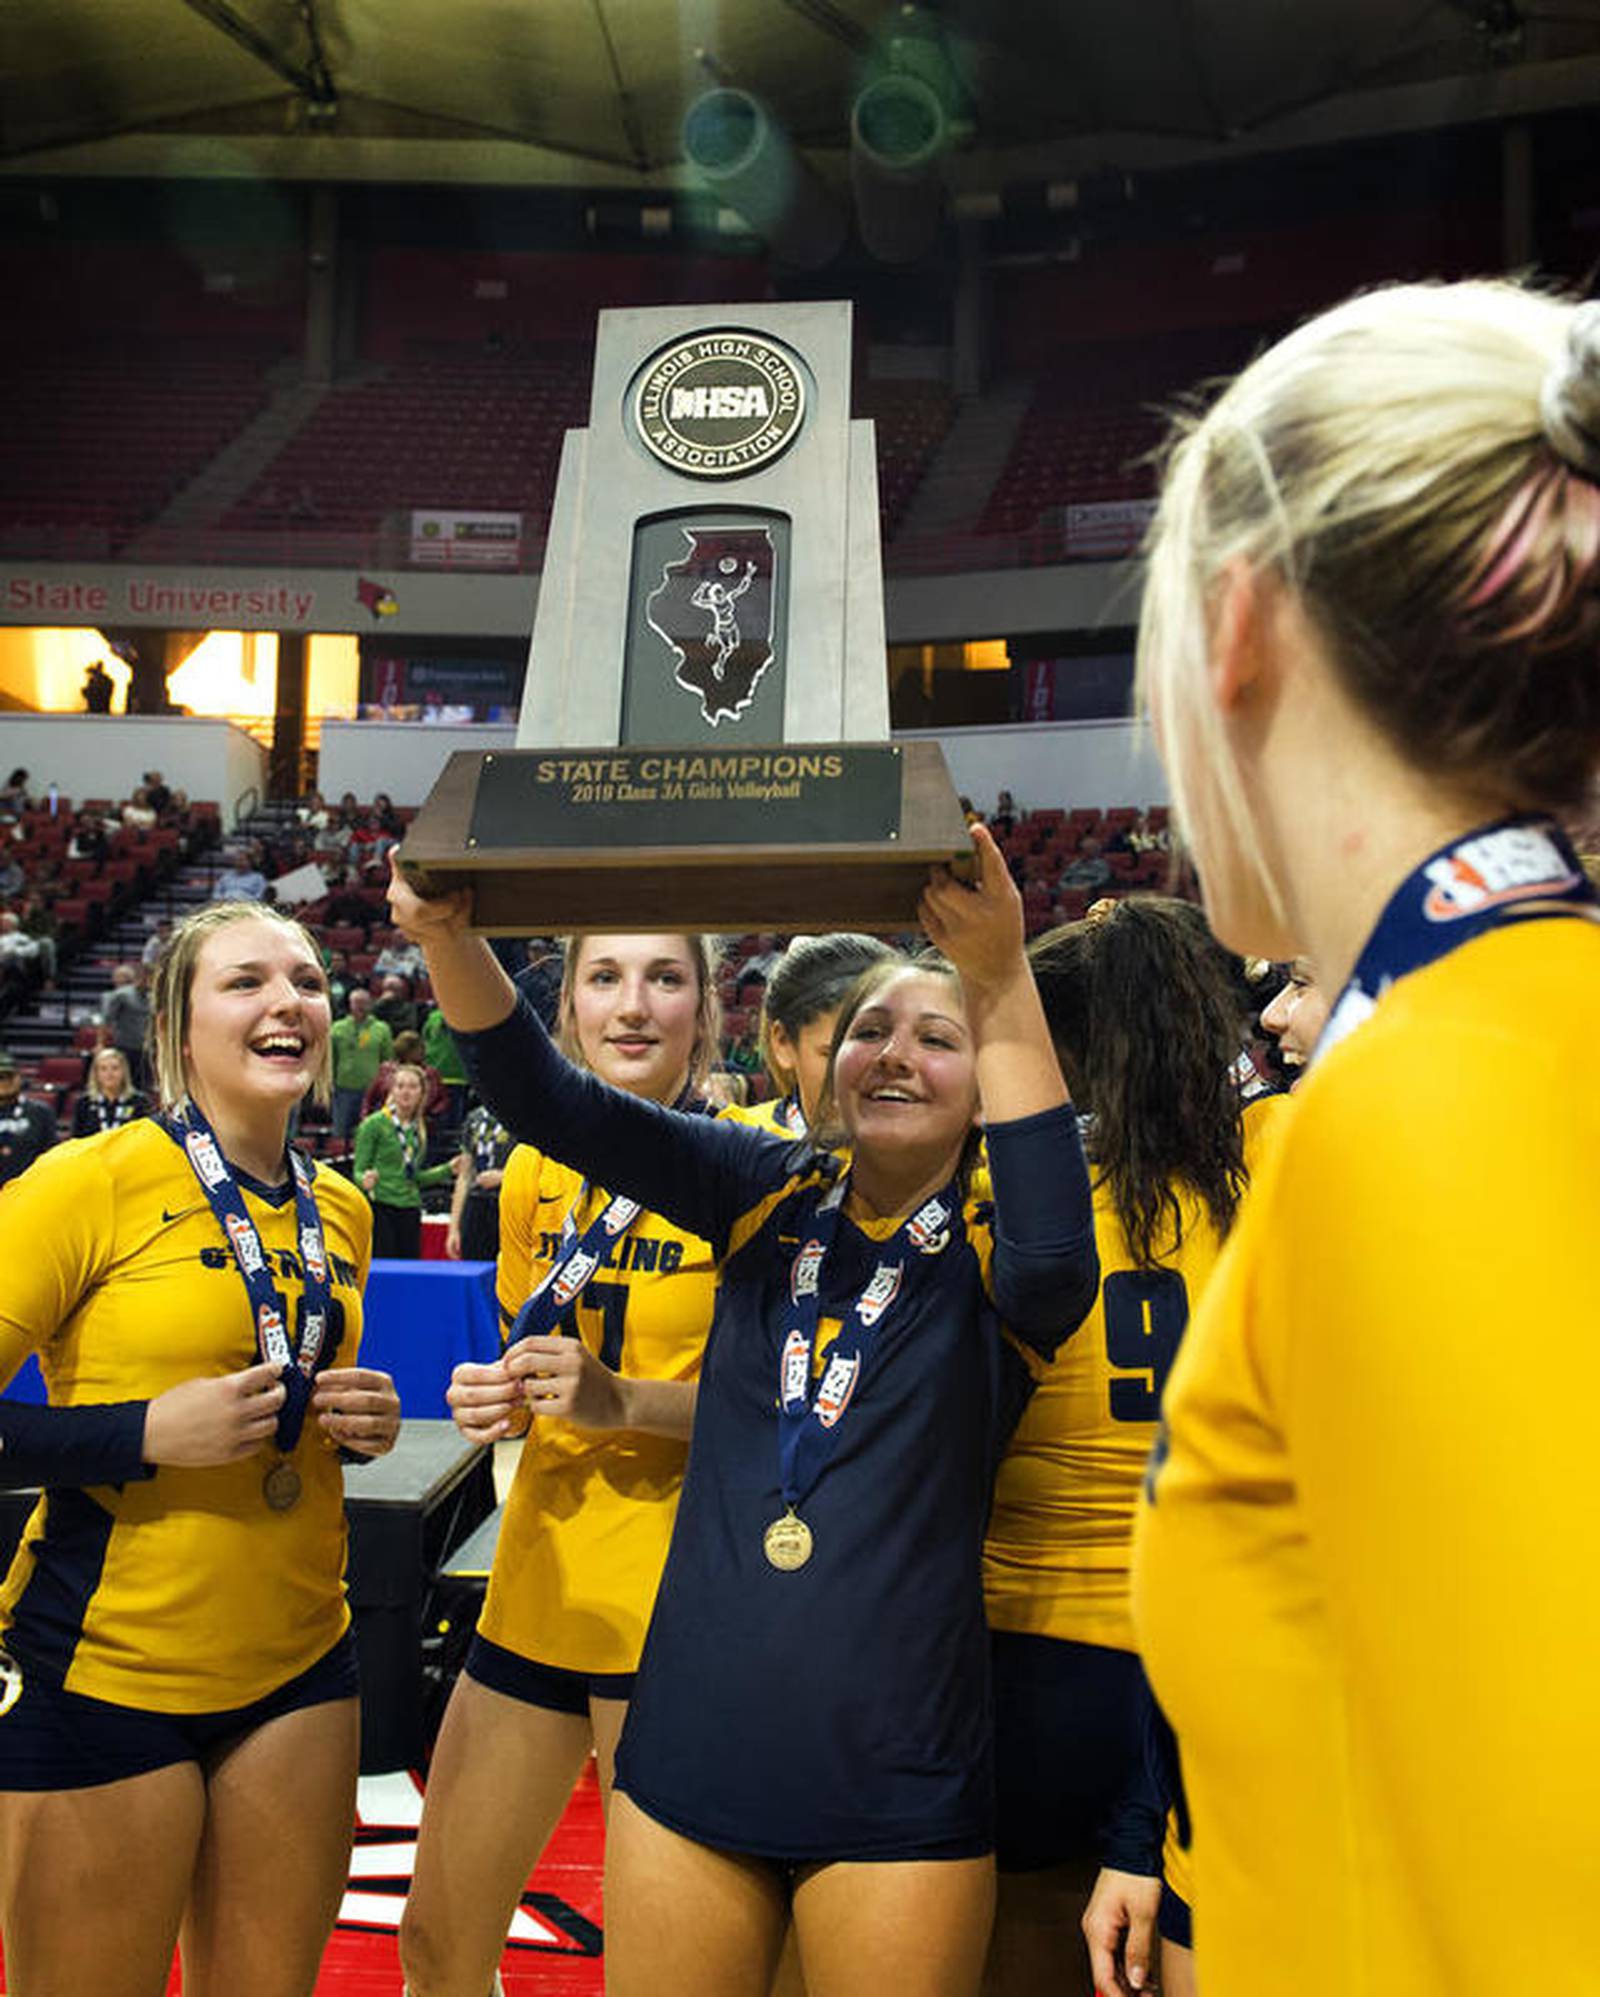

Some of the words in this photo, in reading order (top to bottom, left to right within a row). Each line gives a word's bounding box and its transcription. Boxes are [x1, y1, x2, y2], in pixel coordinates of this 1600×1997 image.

[644, 350, 694, 418] ILLINOIS
[698, 341, 751, 357] HIGH
[753, 349, 797, 414] SCHOOL
[652, 426, 783, 466] ASSOCIATION
[8, 578, 107, 611] State
[128, 583, 314, 619] University
[535, 759, 631, 783] STATE
[639, 755, 843, 781] CHAMPIONS
[617, 783, 657, 800] Class
[661, 782, 684, 799] 3A
[688, 782, 722, 799] Girls
[727, 779, 800, 802] Volleyball
[1102, 1269, 1190, 1422] 9
